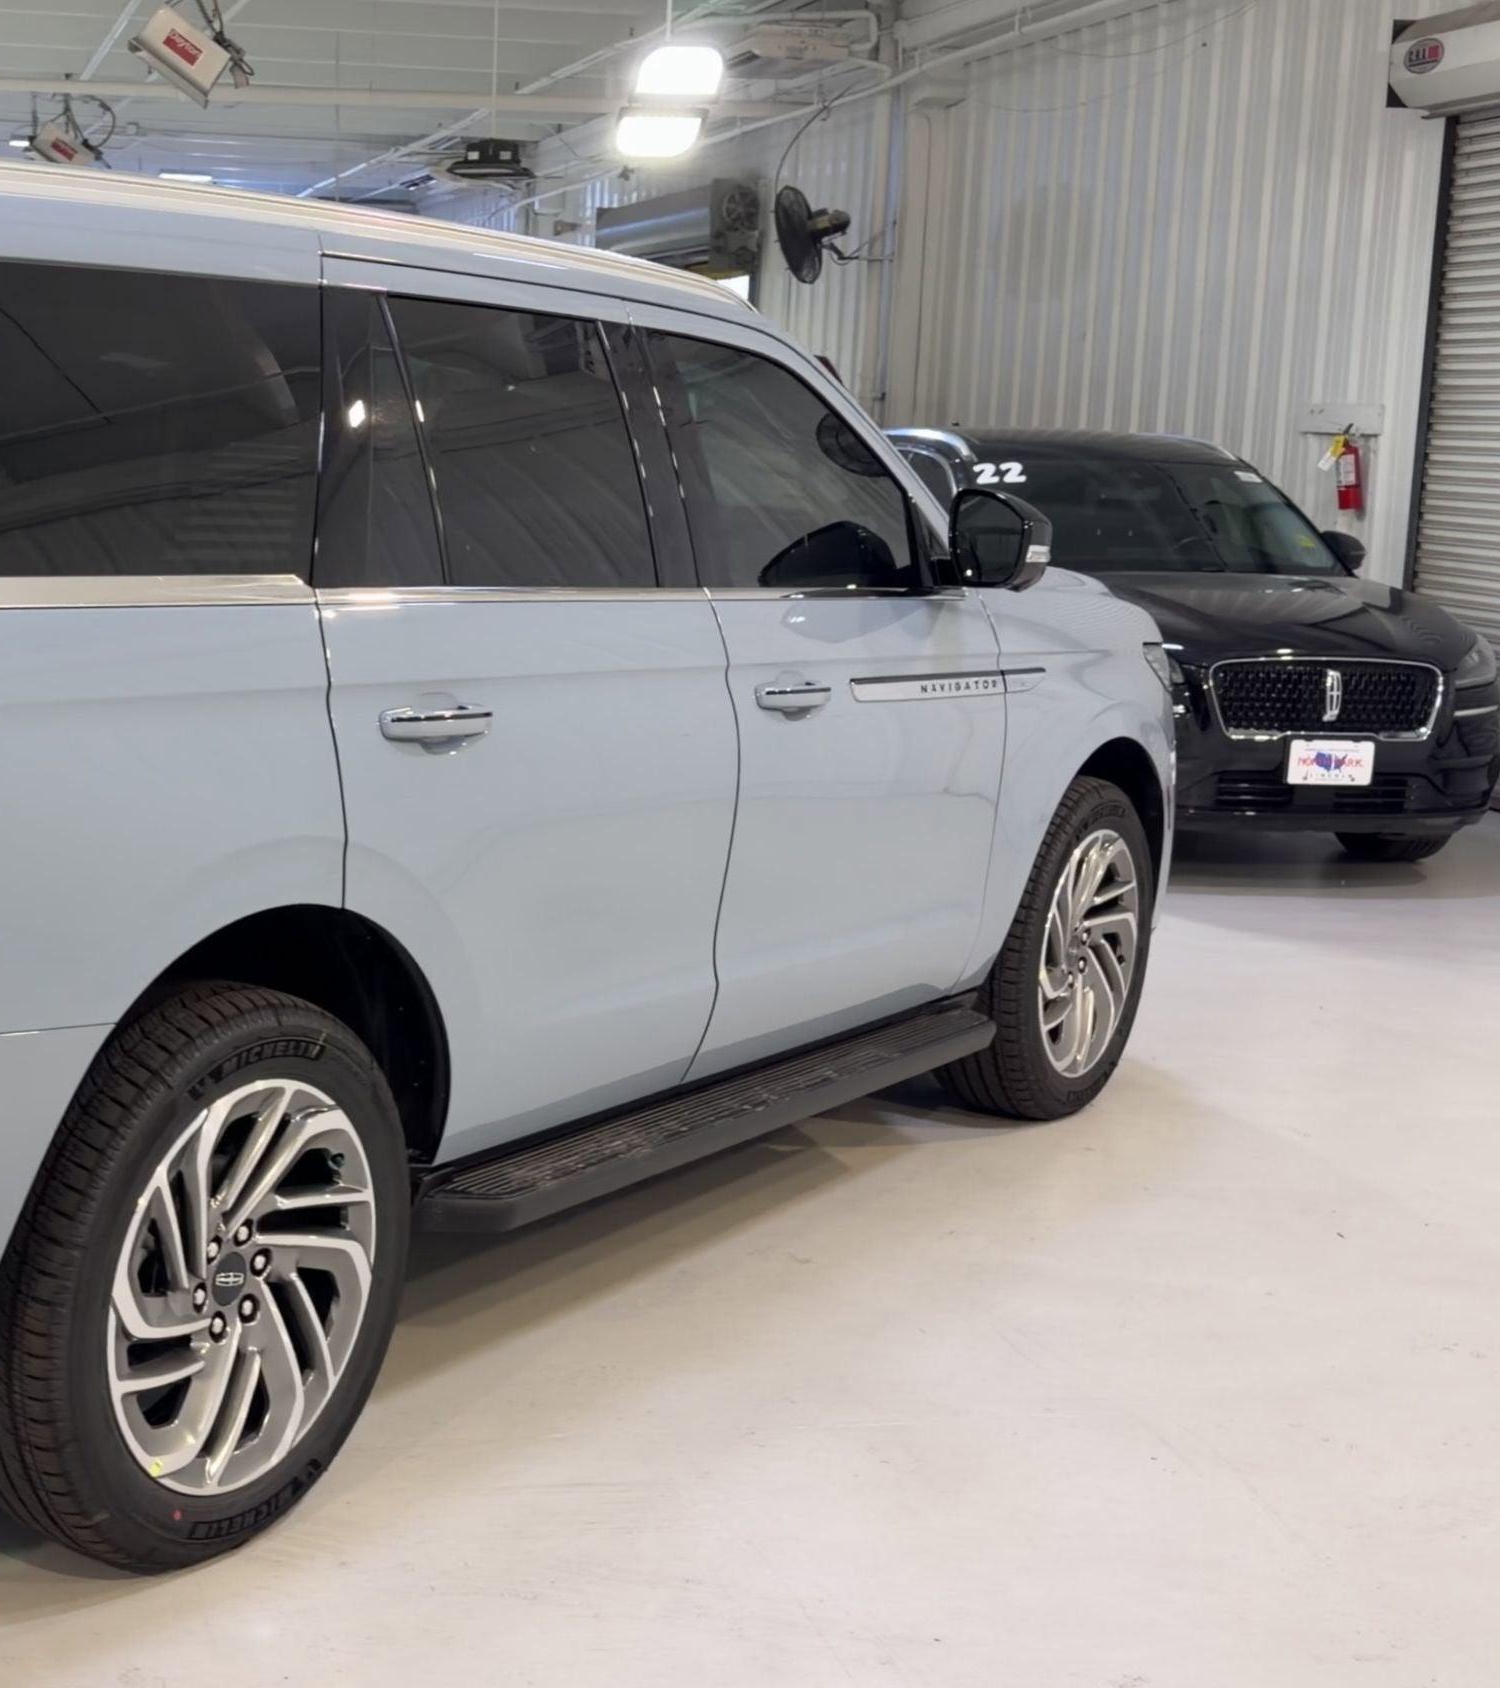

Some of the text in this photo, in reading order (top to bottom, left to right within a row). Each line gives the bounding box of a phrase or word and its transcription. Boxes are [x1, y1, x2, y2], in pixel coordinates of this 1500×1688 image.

[972, 462, 1027, 485] 22
[920, 679, 998, 694] NAVIGATOR
[209, 1037, 325, 1083] MICHELIN
